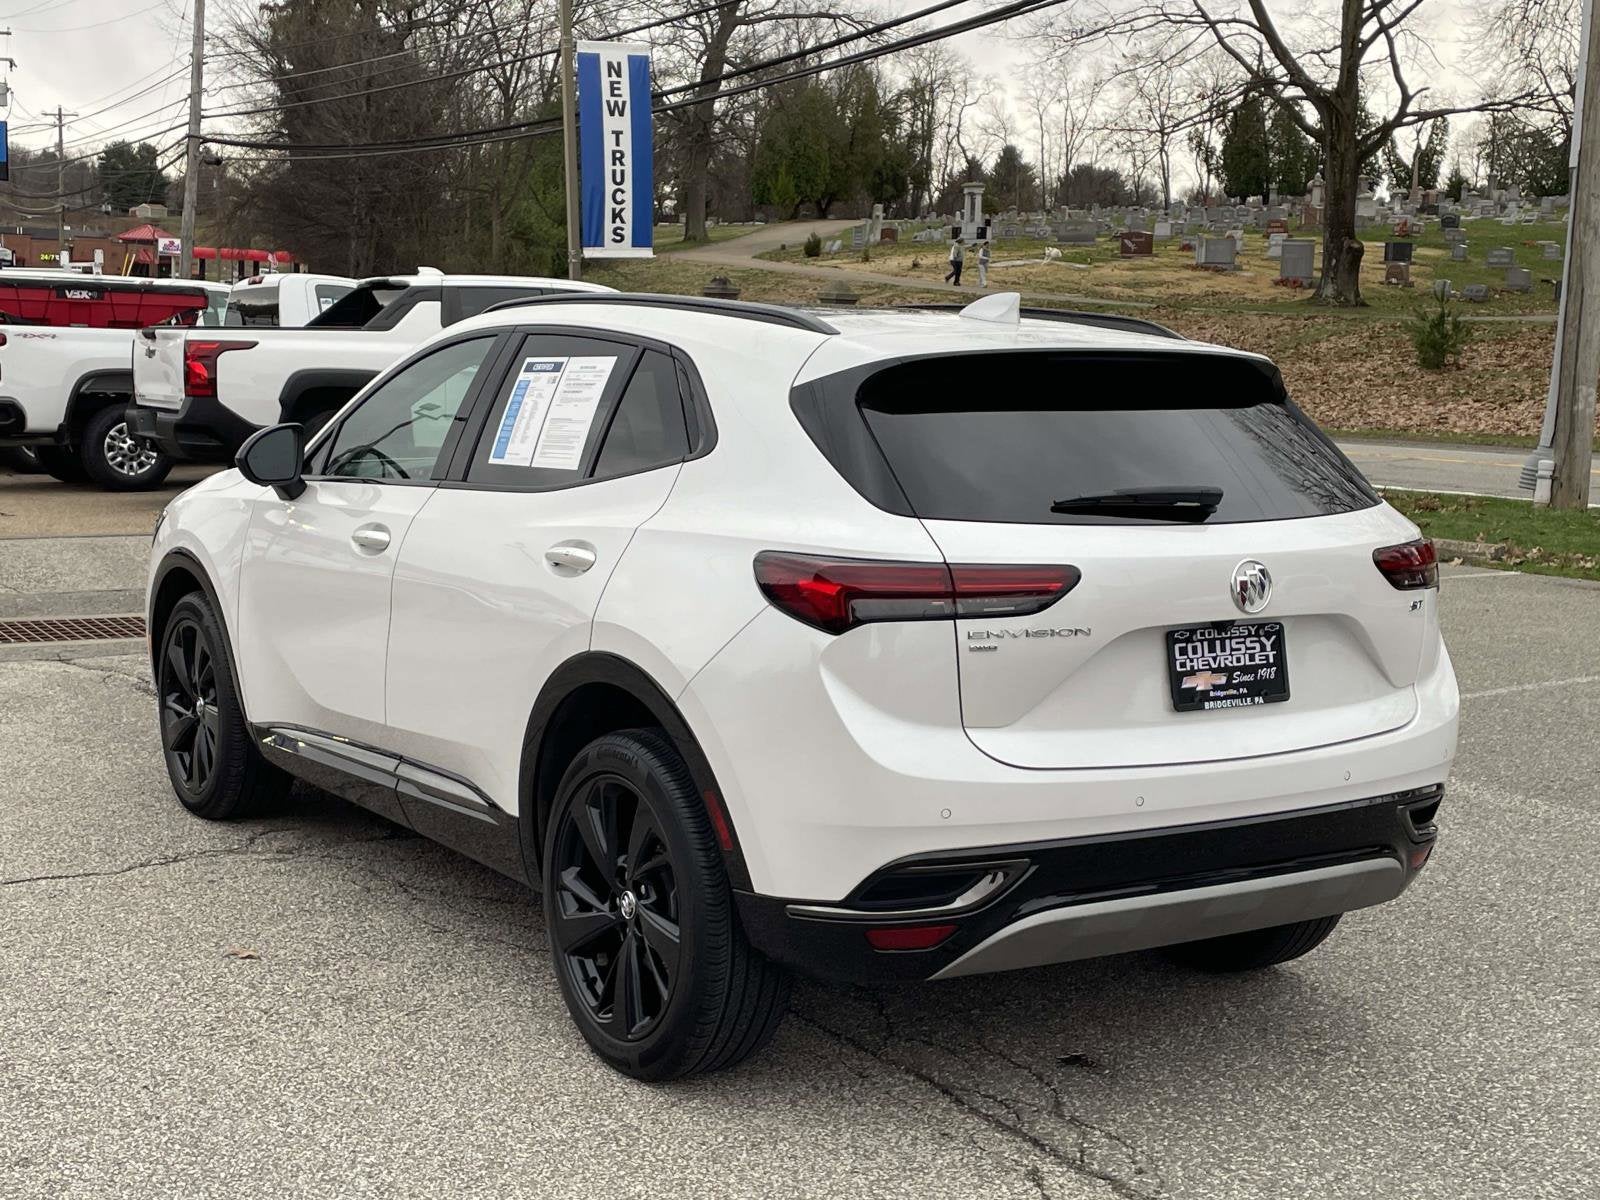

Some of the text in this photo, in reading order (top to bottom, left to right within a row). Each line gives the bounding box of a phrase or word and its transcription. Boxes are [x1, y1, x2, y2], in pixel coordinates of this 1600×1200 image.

[606, 60, 627, 244] NEW TRUCKS
[967, 627, 1092, 640] ENVISION
[1197, 625, 1258, 639] COLUSSY
[1174, 635, 1277, 659] COLUSSY
[1176, 651, 1277, 671] CHEVROLET
[1232, 666, 1277, 684] Since 1918
[1254, 696, 1265, 705] PA
